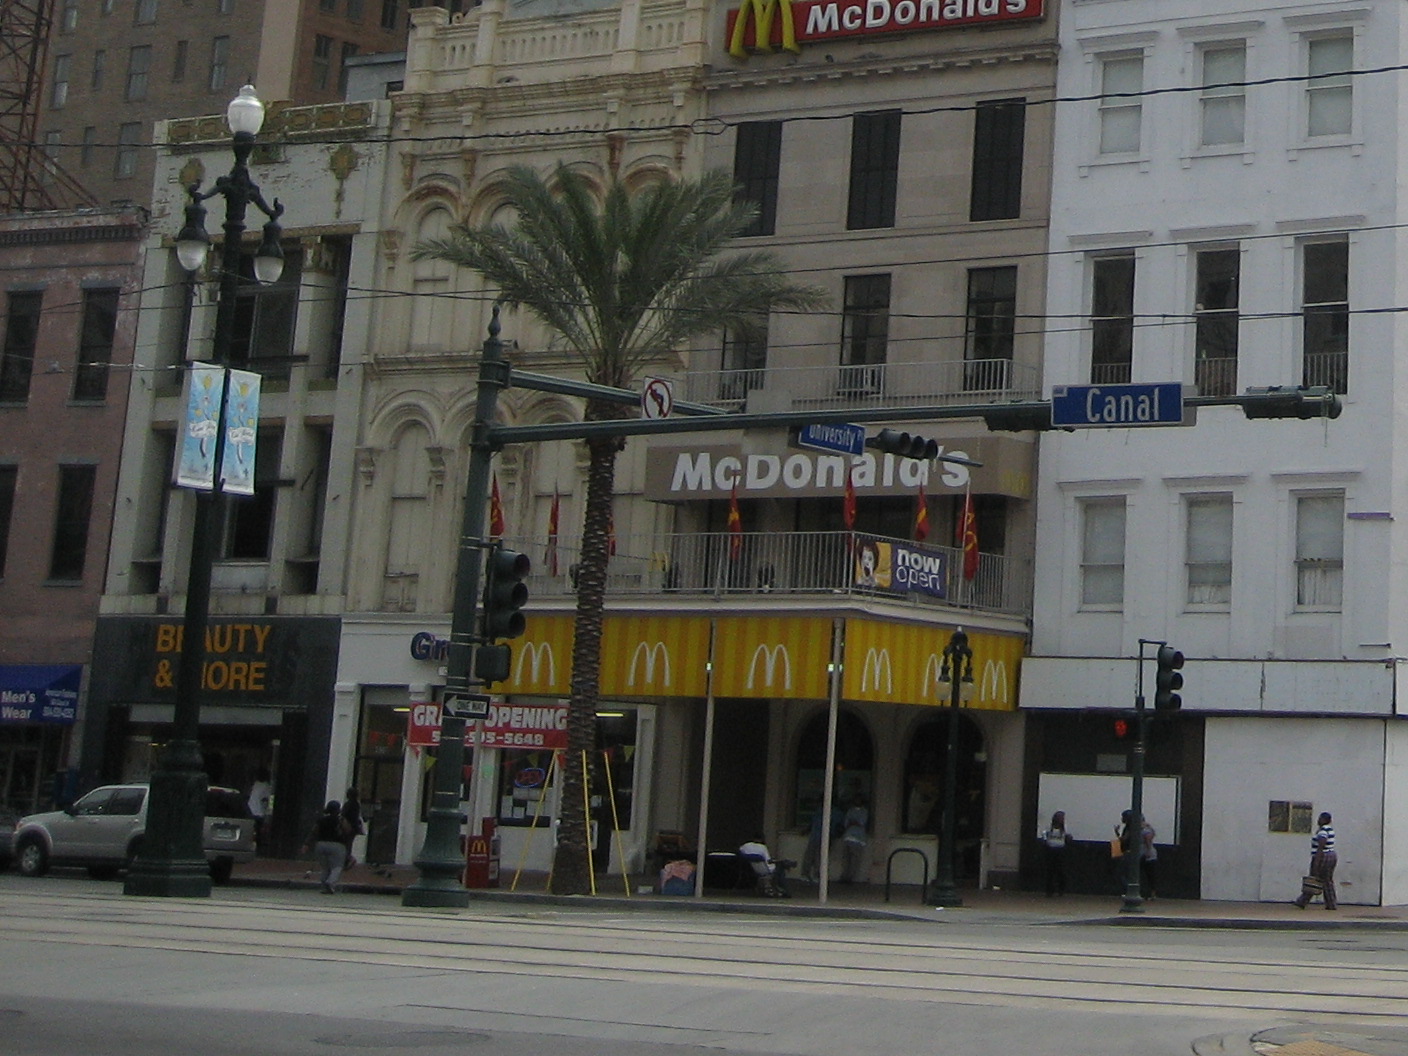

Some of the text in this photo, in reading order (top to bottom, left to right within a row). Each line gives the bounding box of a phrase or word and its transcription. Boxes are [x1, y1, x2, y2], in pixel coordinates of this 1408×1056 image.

[1086, 387, 1160, 423] Canal
[808, 423, 856, 452] University
[897, 547, 941, 574] now
[895, 565, 941, 591] open
[155, 658, 173, 688] &
[1, 690, 37, 703] Men's
[1, 706, 32, 719] Wear
[484, 706, 568, 731] OPENING
